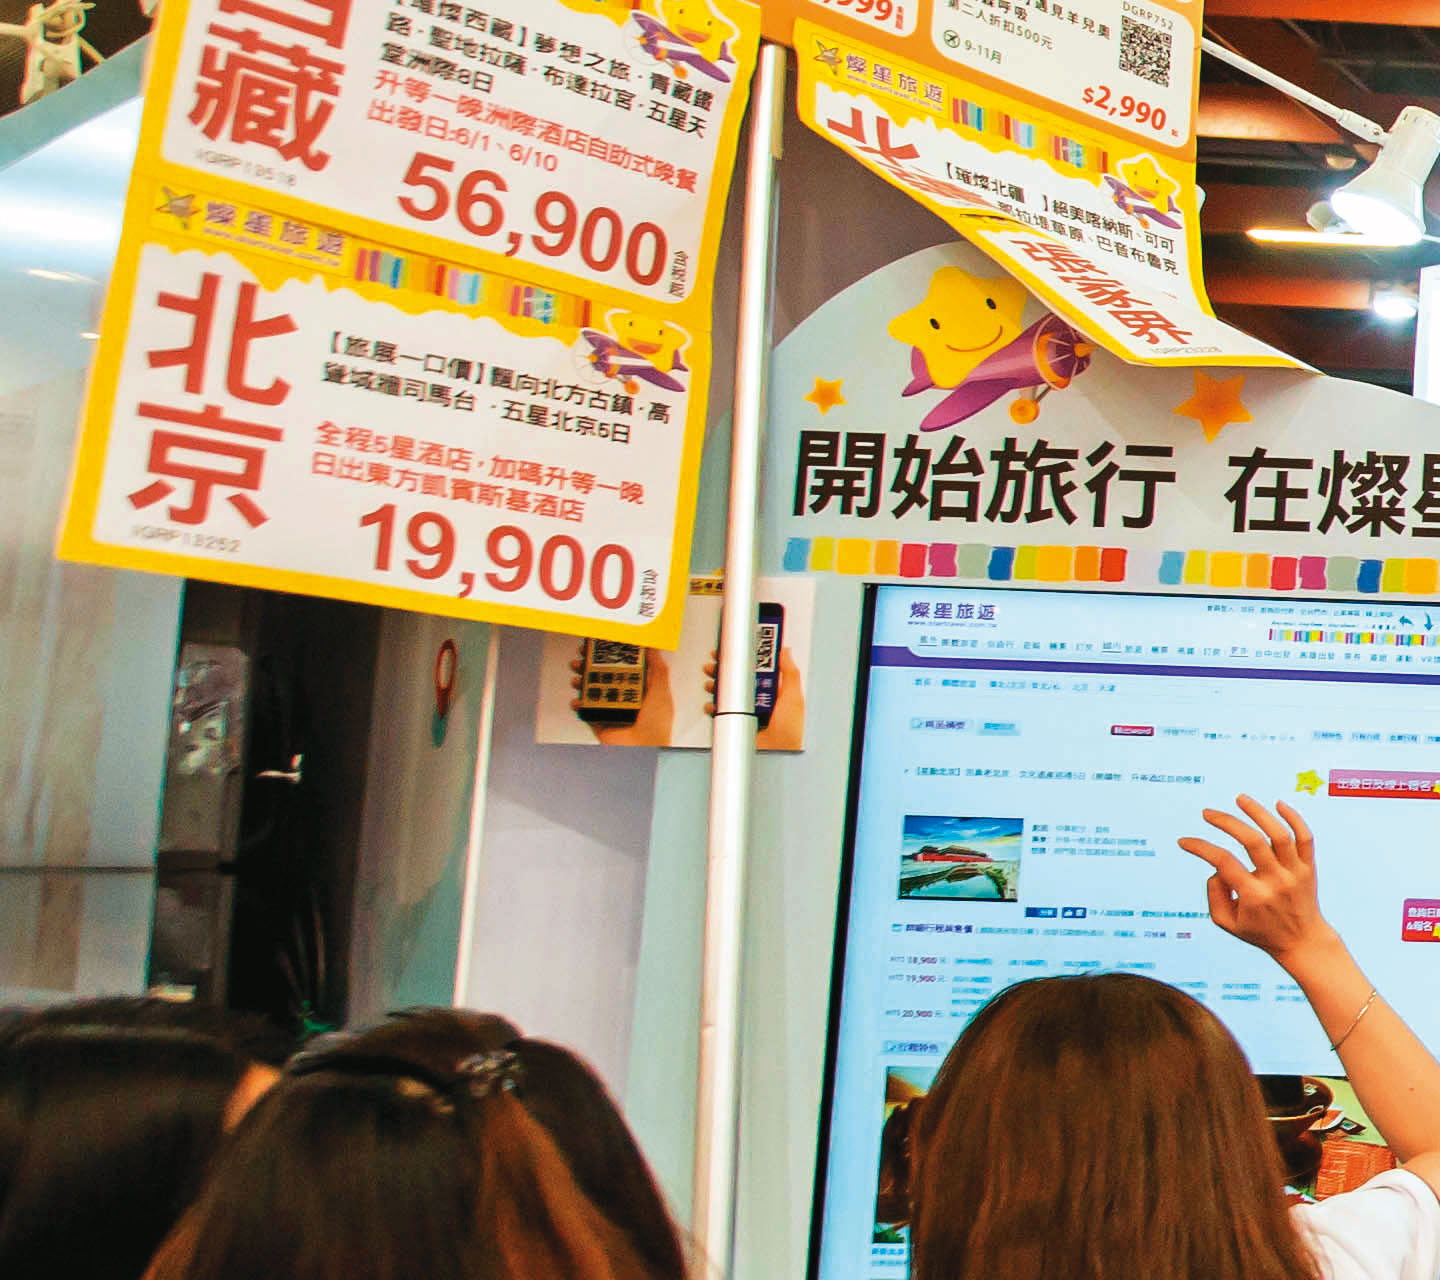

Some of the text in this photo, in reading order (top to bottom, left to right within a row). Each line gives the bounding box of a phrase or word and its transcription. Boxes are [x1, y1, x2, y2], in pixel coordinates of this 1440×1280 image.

[373, 68, 701, 195] 升等一晚洲際酒店自助式晚餐
[845, 51, 946, 106] 燦星旅遊
[1081, 84, 1168, 132] $2,990
[395, 149, 670, 288] 56,900
[127, 270, 302, 532] 北京
[792, 428, 1177, 531] 開始旅行
[358, 502, 636, 611] 19,900
[908, 601, 997, 621] 燦星旅遊
